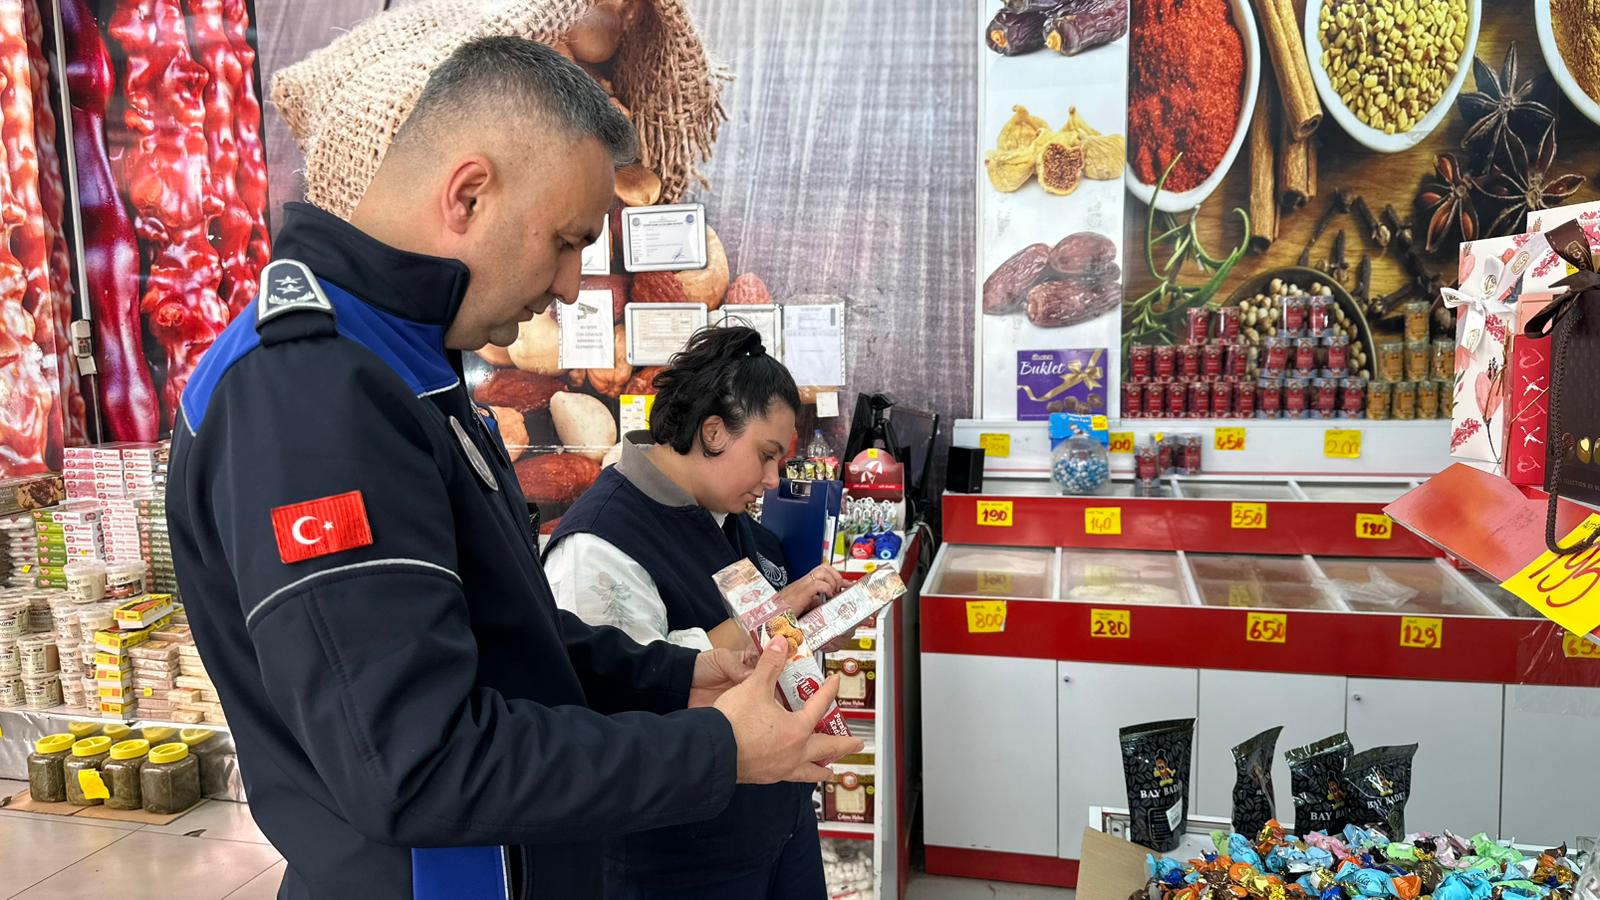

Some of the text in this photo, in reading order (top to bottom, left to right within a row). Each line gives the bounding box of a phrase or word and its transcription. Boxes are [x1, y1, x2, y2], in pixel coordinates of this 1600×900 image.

[1020, 361, 1065, 375] Buklet
[982, 508, 1007, 522] 190
[1233, 509, 1263, 526] 350
[1090, 517, 1111, 533] 140
[1362, 521, 1387, 536] 180
[975, 612, 1003, 628] 800
[1093, 620, 1128, 636] 280
[1249, 620, 1285, 640] 650
[1403, 624, 1438, 648] 129
[1140, 788, 1161, 799] BAY
[1310, 811, 1332, 821] BAY
